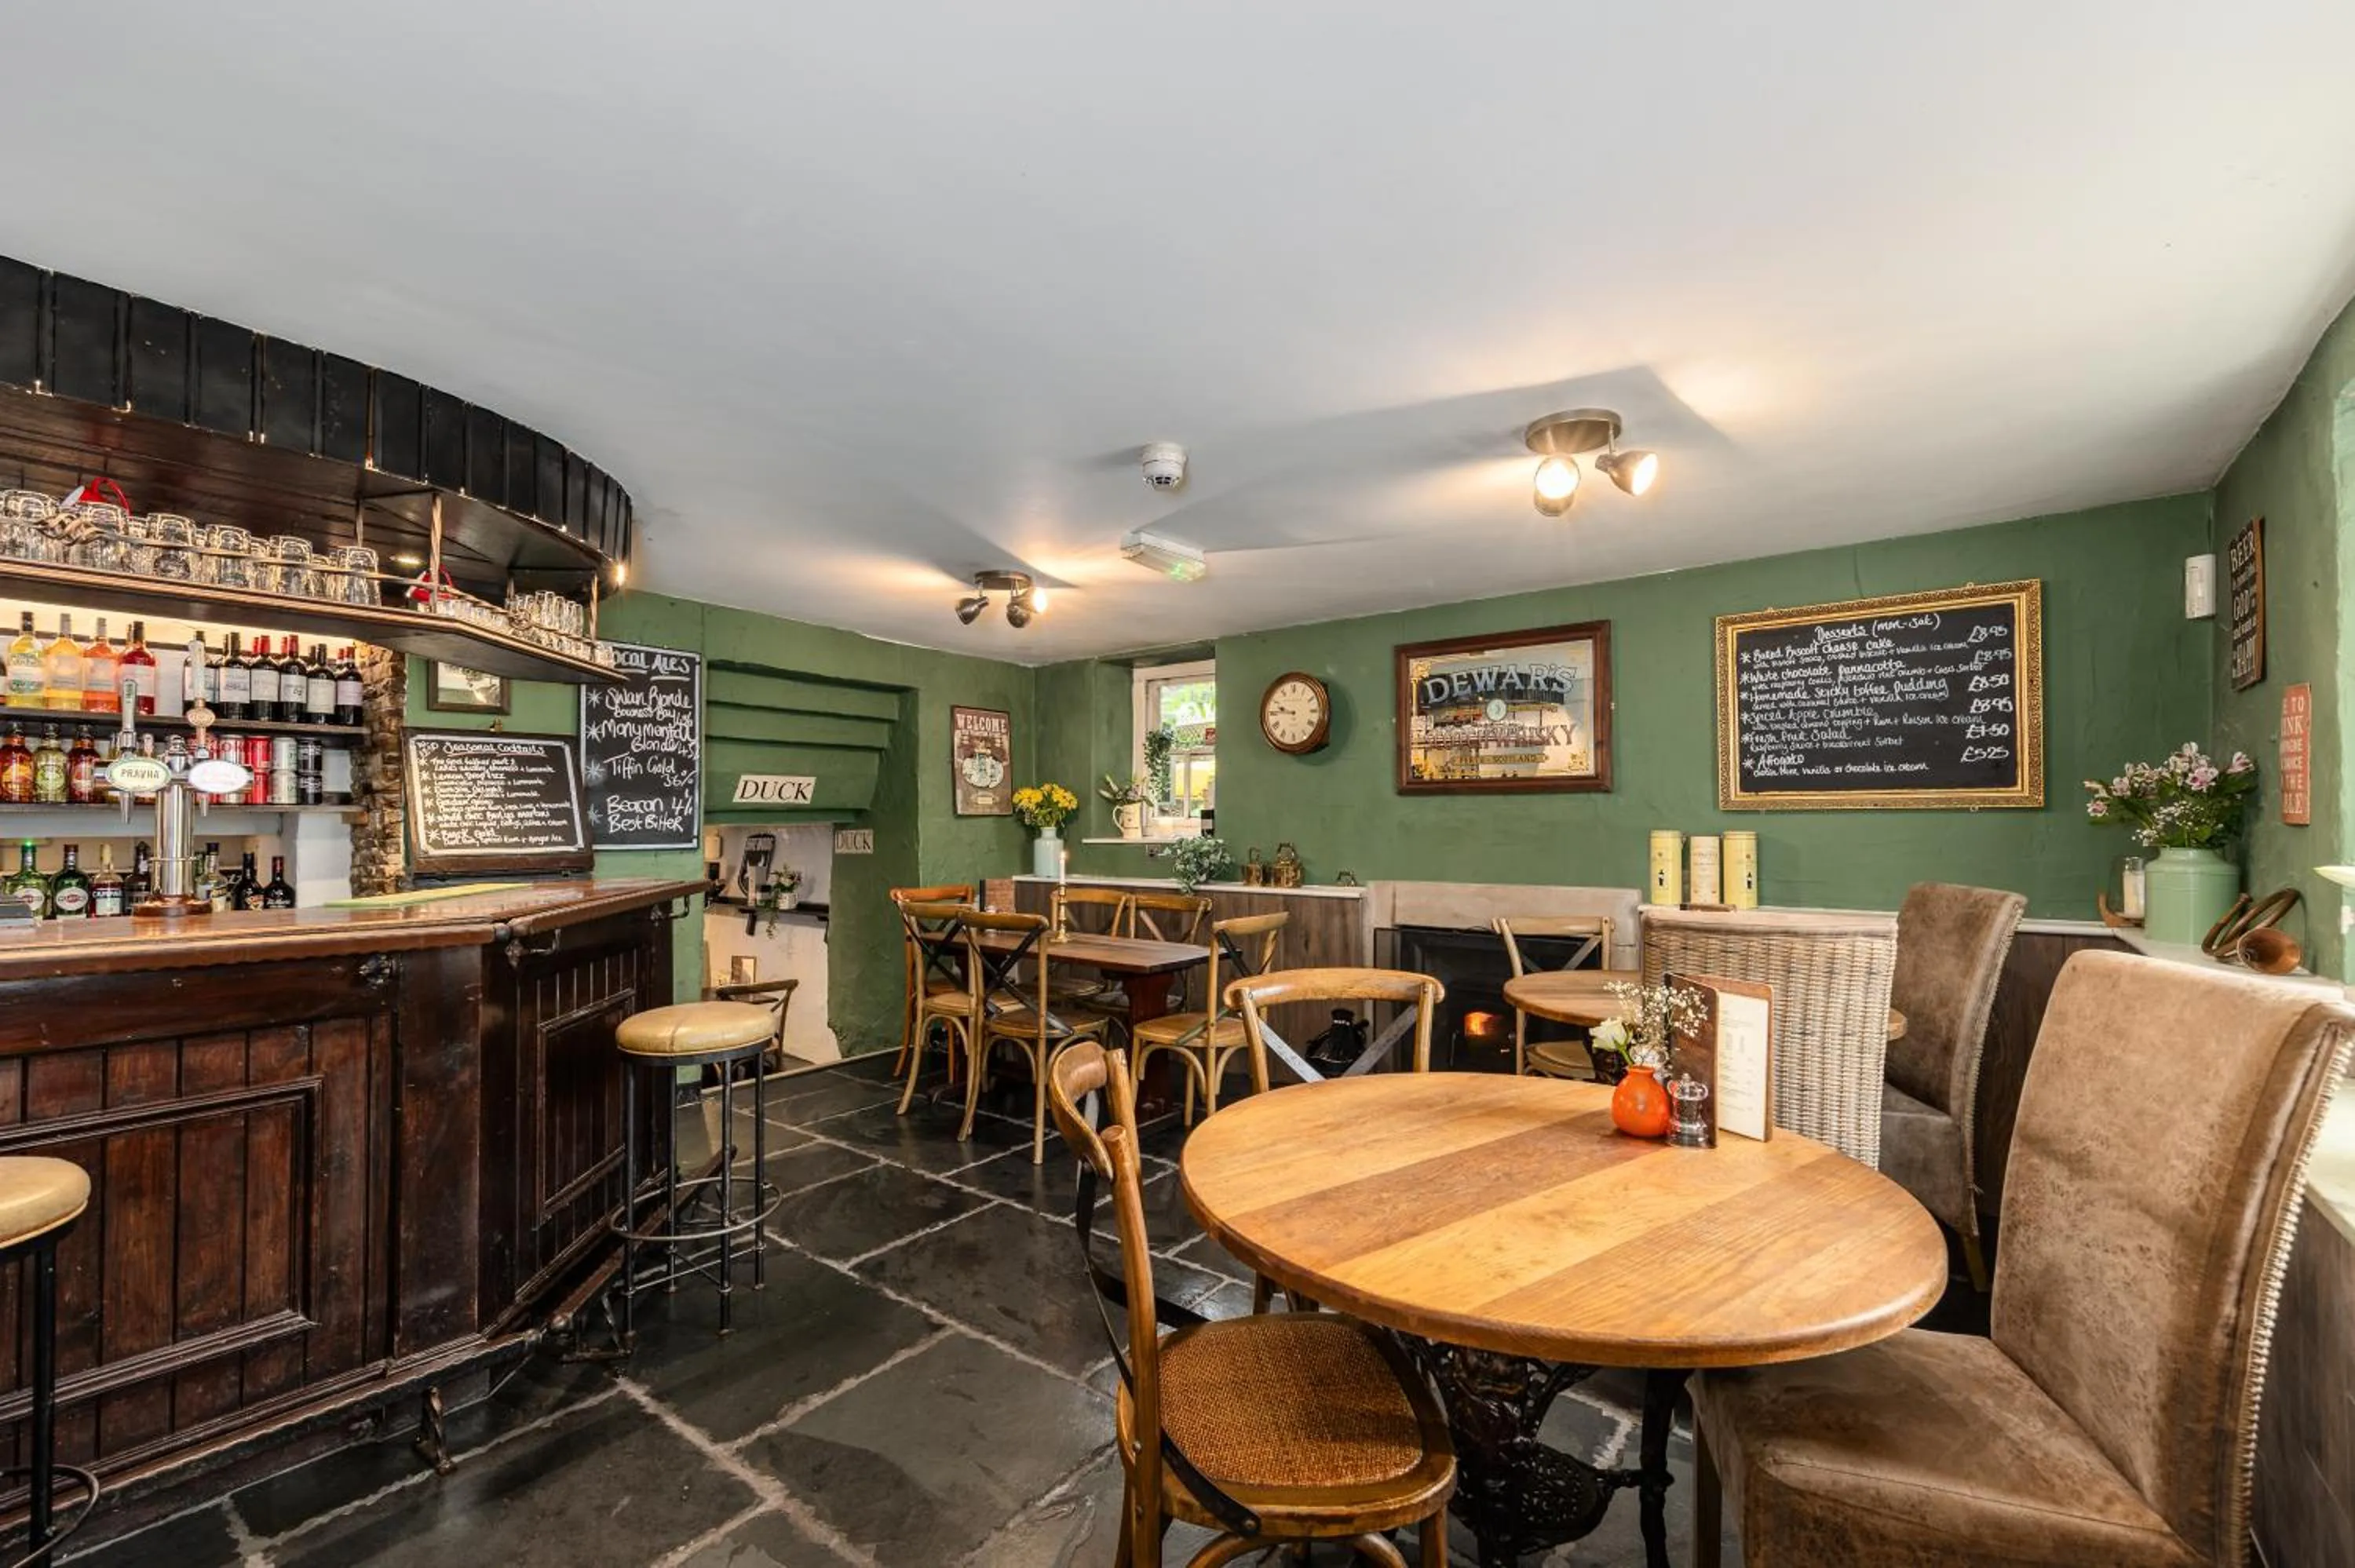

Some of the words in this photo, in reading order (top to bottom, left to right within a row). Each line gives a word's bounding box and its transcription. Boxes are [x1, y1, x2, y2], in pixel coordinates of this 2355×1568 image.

[2230, 530, 2255, 573] BEER
[1425, 662, 1577, 704] DEWAR'S
[956, 713, 1007, 733] WELCOME
[739, 779, 812, 801] DUCK
[606, 794, 663, 815] Beacon
[608, 813, 643, 833] Best
[836, 830, 871, 850] DUCK
